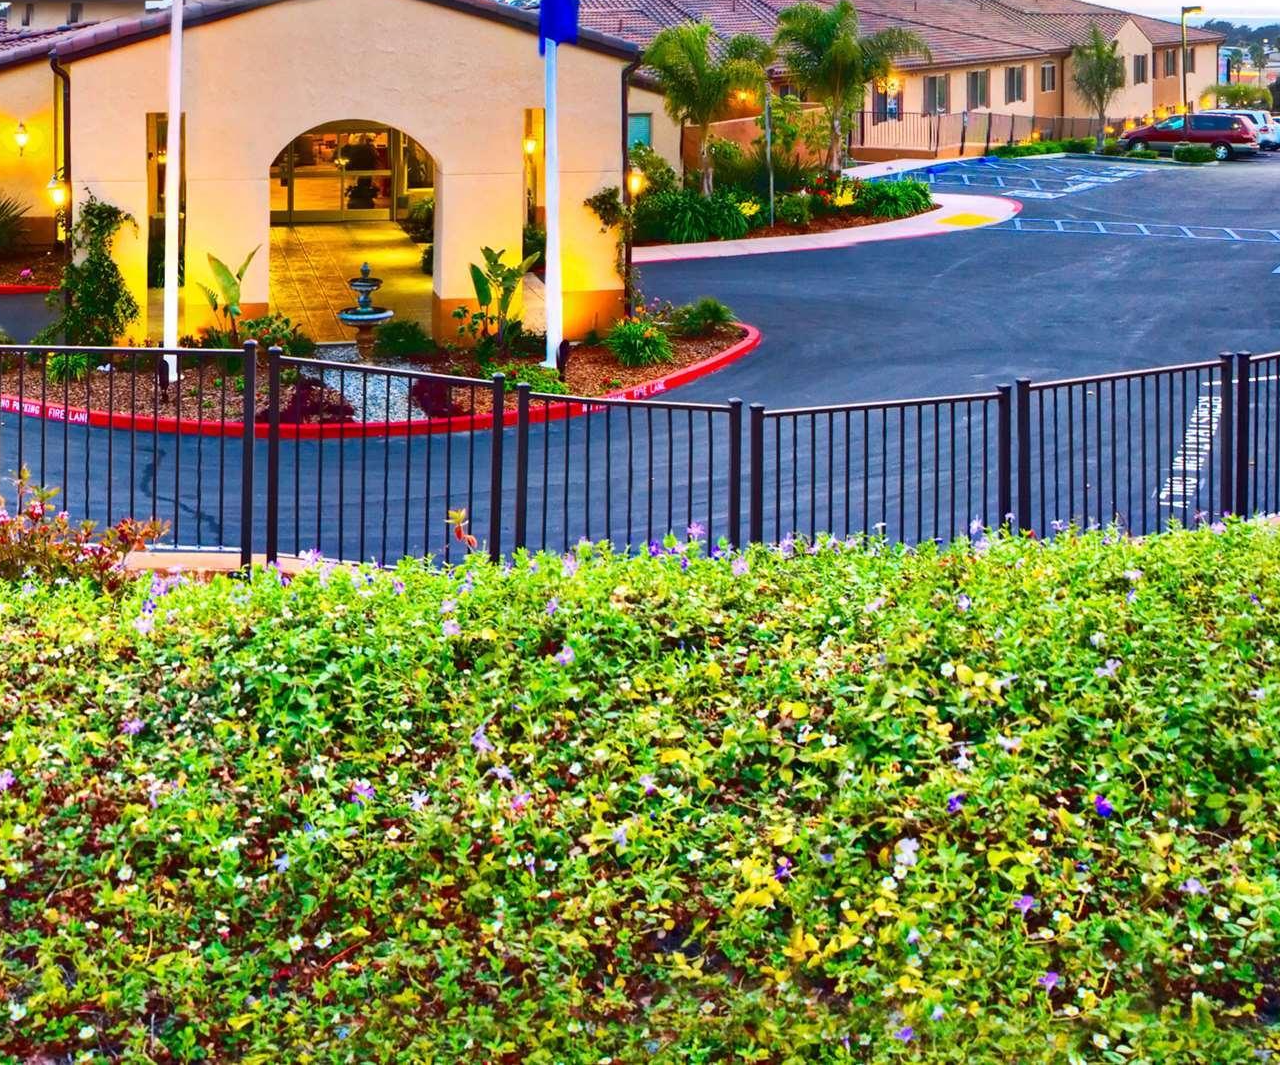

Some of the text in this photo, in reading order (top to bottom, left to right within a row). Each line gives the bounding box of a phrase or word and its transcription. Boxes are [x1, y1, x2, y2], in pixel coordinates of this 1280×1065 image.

[0, 398, 10, 408] NO
[48, 408, 65, 419] FIRE
[1159, 476, 1198, 509] ONLY
